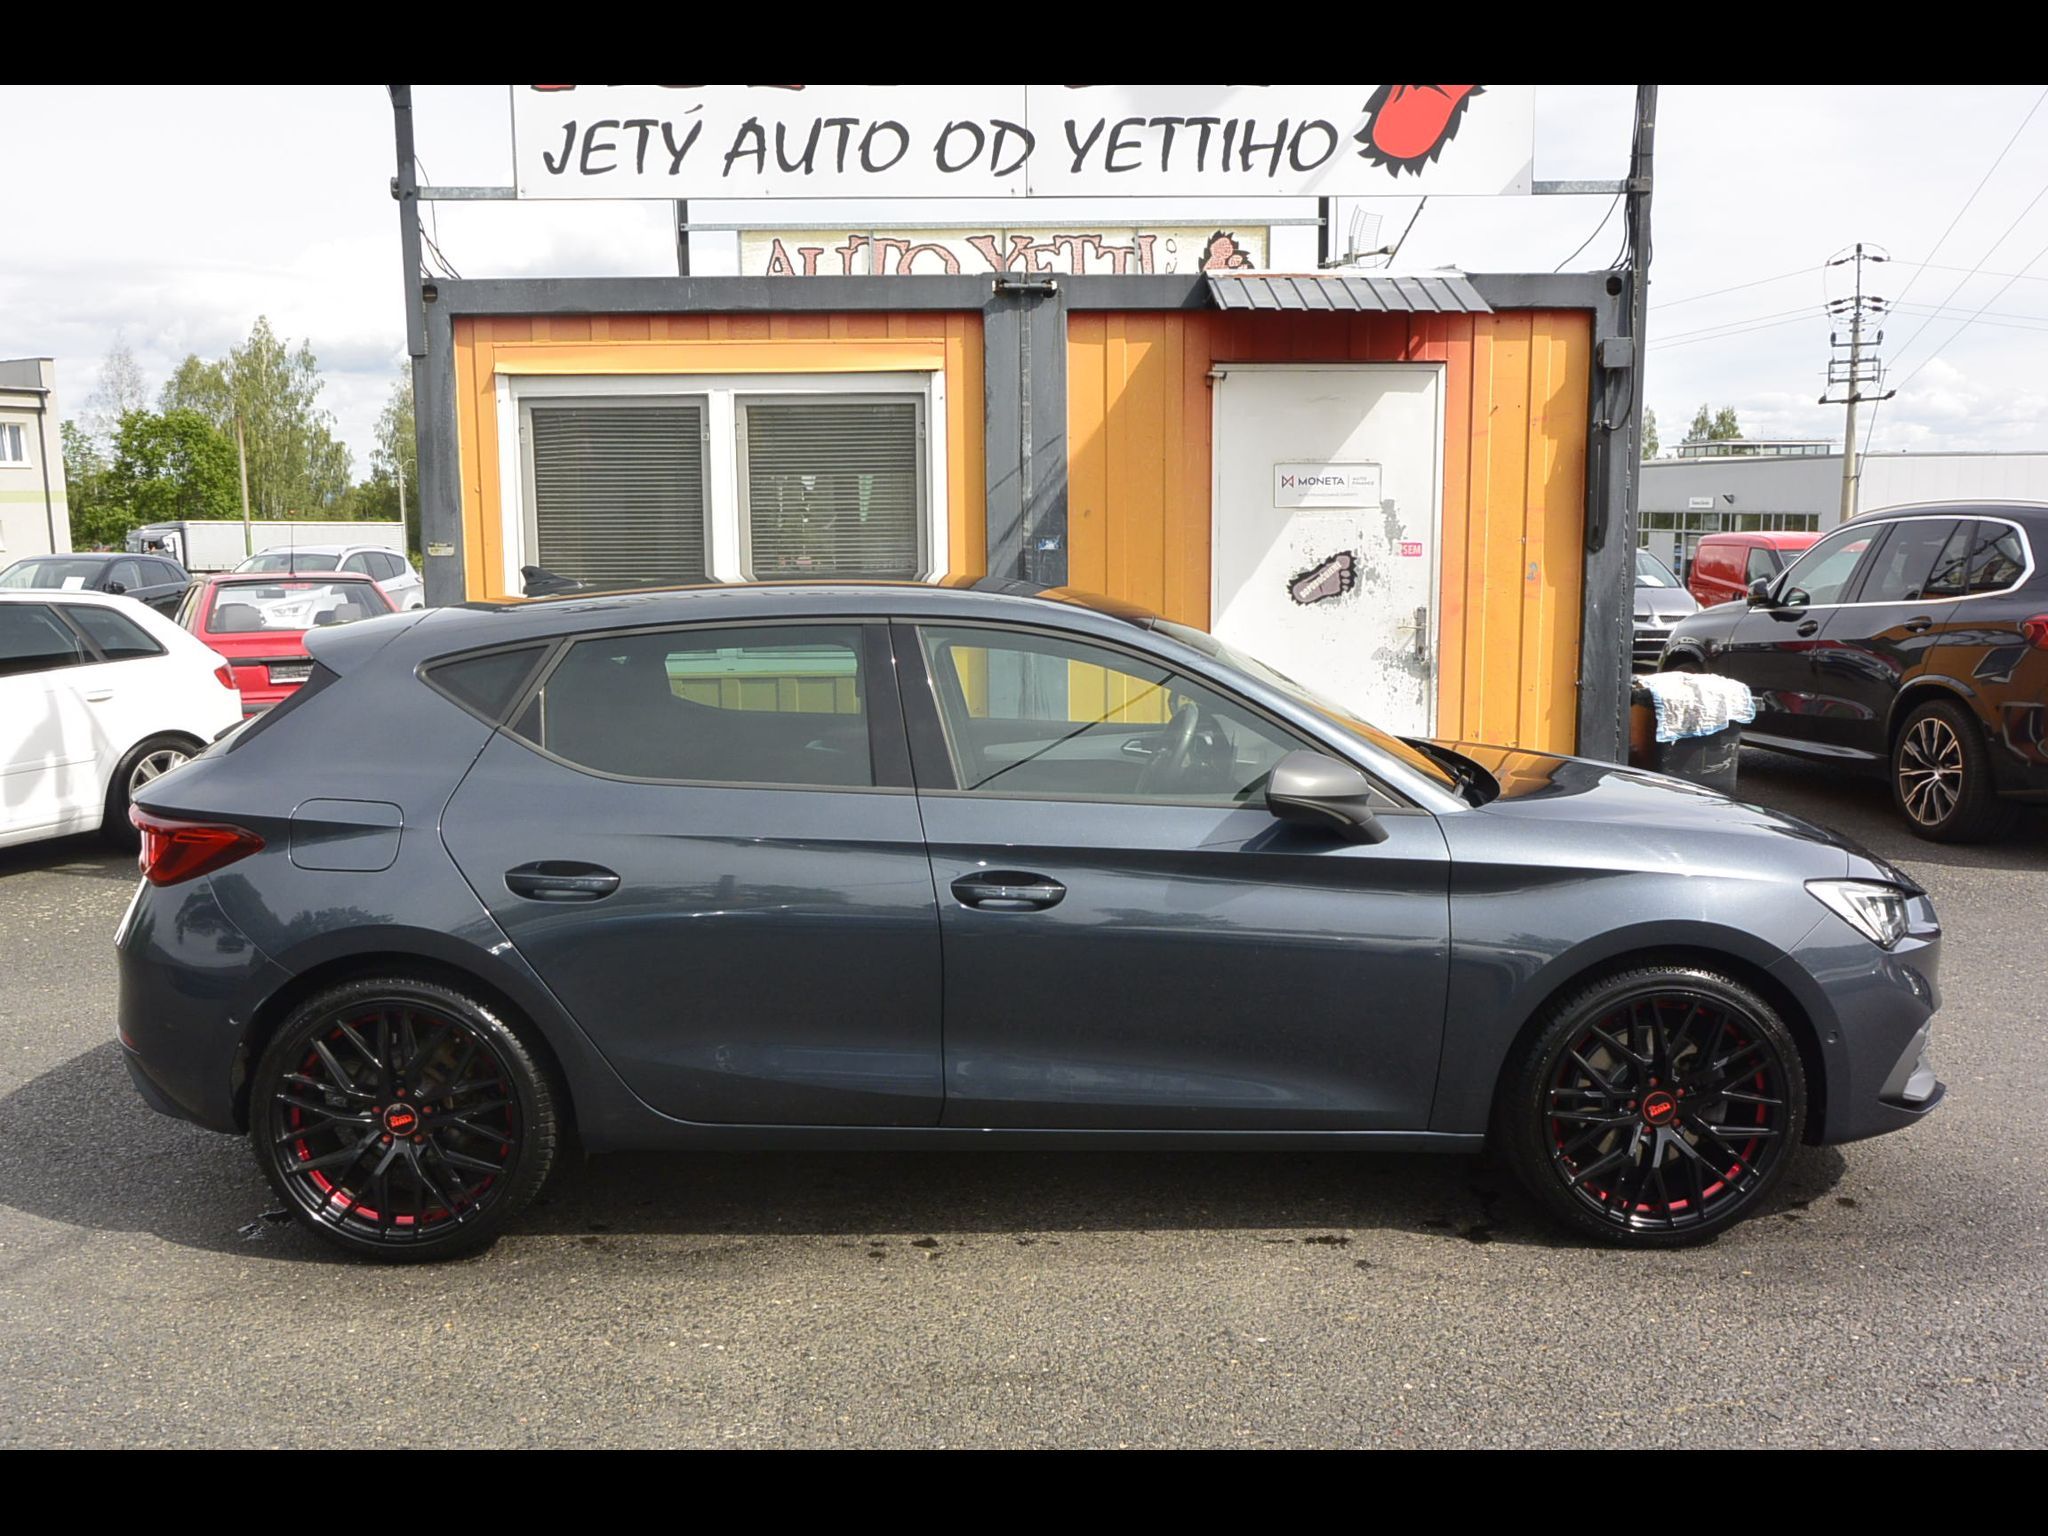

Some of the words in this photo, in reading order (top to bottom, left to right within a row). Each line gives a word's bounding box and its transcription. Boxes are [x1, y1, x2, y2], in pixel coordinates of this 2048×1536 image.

[541, 103, 704, 176] JETÝ
[722, 116, 910, 177] AUTO
[933, 118, 1036, 178] OD
[1063, 116, 1339, 178] YETTIHO
[1298, 476, 1345, 486] MONETA
